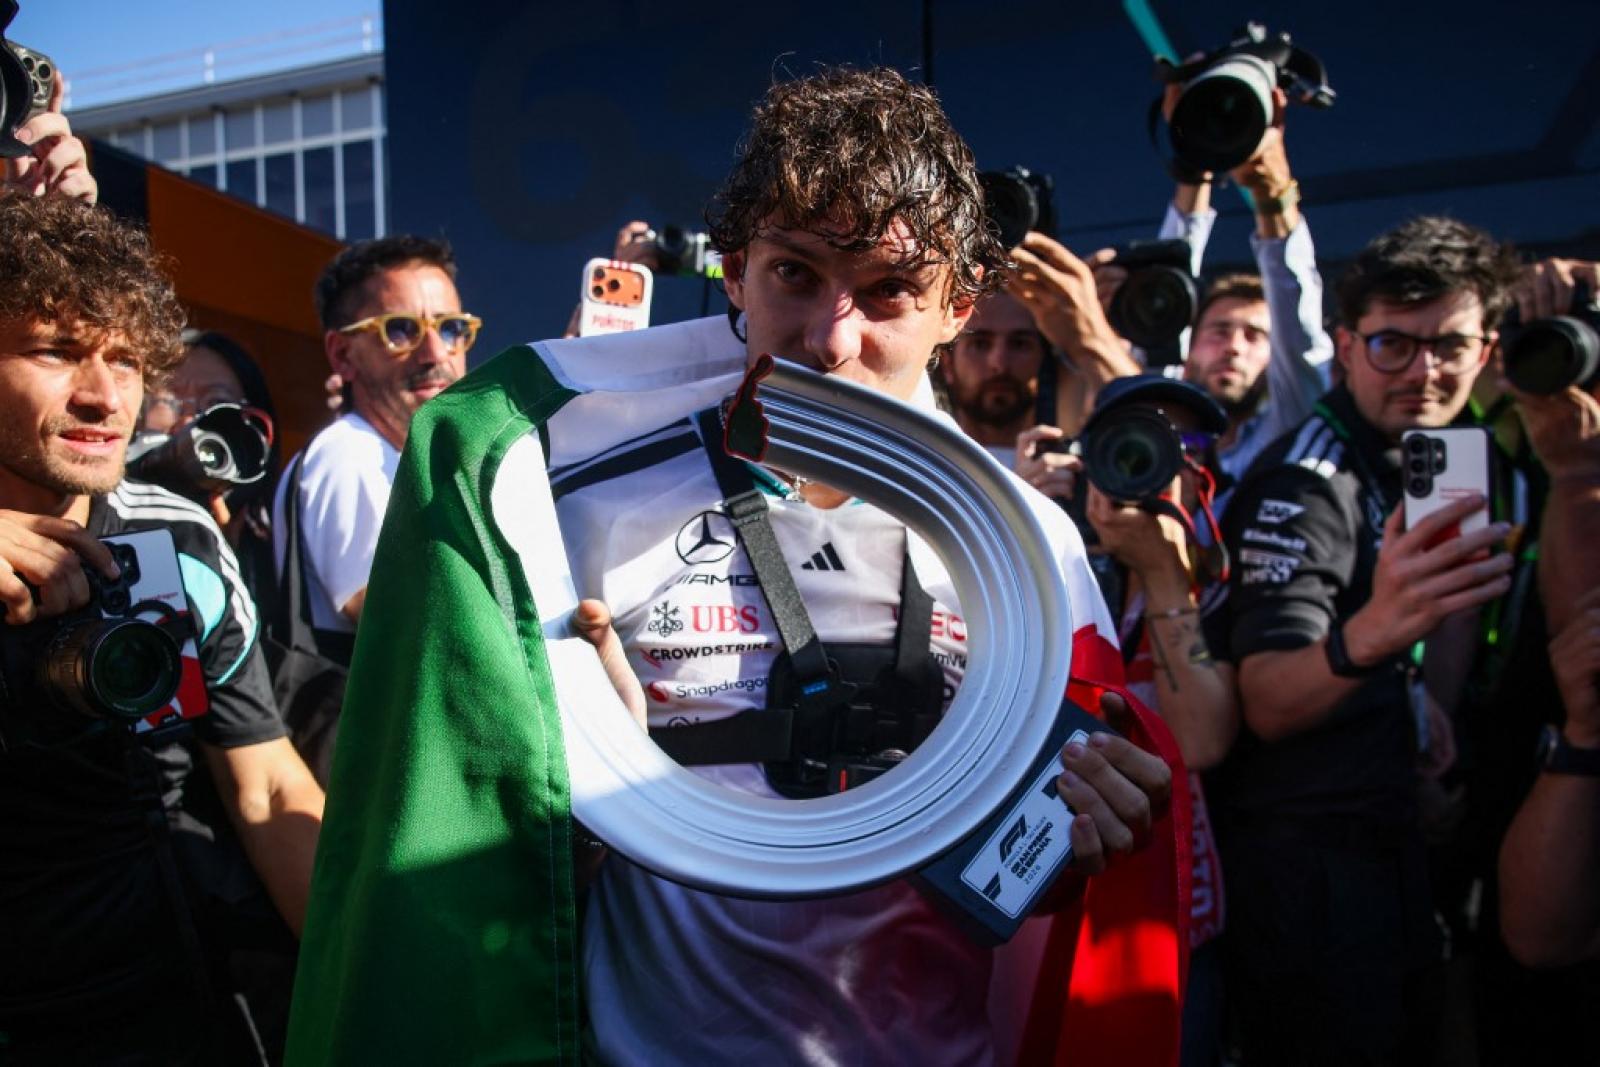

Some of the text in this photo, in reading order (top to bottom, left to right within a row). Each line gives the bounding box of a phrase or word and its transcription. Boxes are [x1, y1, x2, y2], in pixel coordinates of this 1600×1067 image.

[688, 574, 759, 586] AMG
[691, 605, 759, 633] UBS
[651, 642, 774, 661] CROWDSTRIKE
[1010, 849, 1031, 874] GRAN
